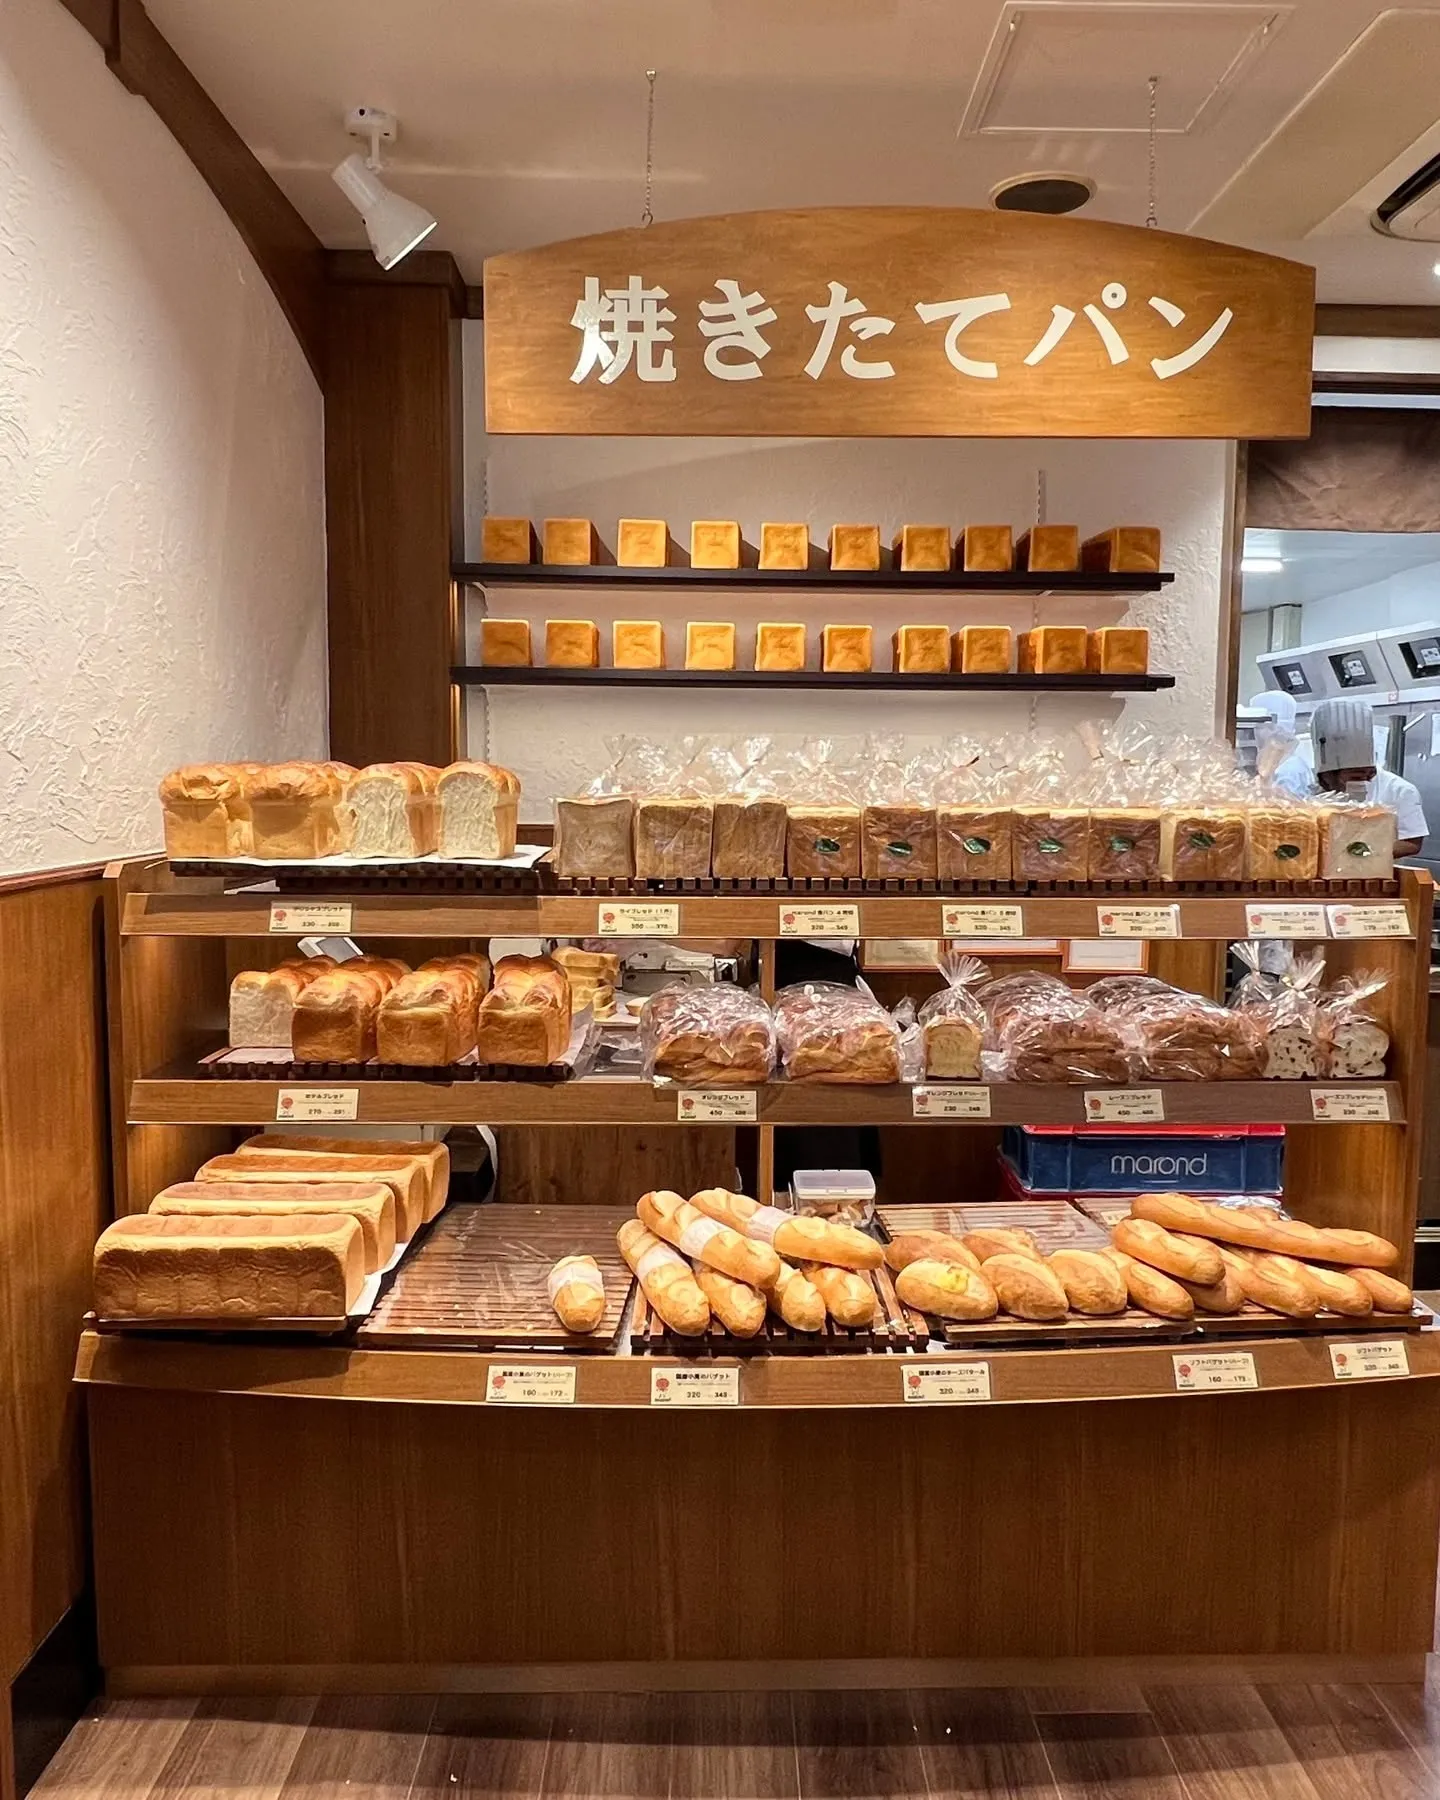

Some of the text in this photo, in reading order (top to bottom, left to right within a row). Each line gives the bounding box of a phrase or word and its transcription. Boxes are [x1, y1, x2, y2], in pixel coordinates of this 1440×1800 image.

[570, 275, 1234, 385] 焼きたてパン
[1110, 1152, 1208, 1176] marond
